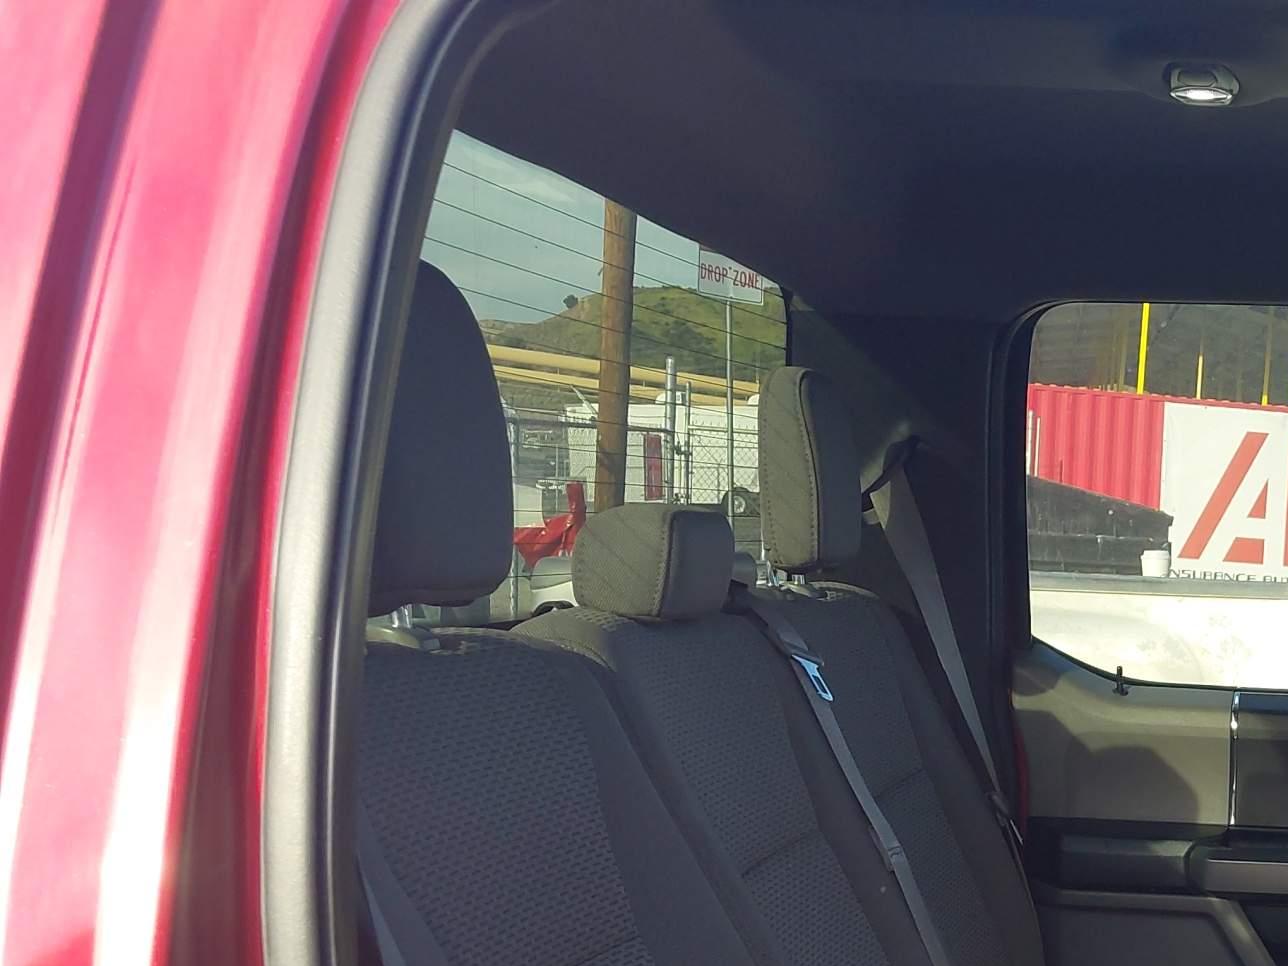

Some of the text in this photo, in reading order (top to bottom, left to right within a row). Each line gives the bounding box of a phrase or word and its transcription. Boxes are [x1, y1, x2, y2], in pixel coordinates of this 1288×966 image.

[700, 262, 760, 289] DROP ZONE
[1167, 568, 1257, 582] NSURANCE
